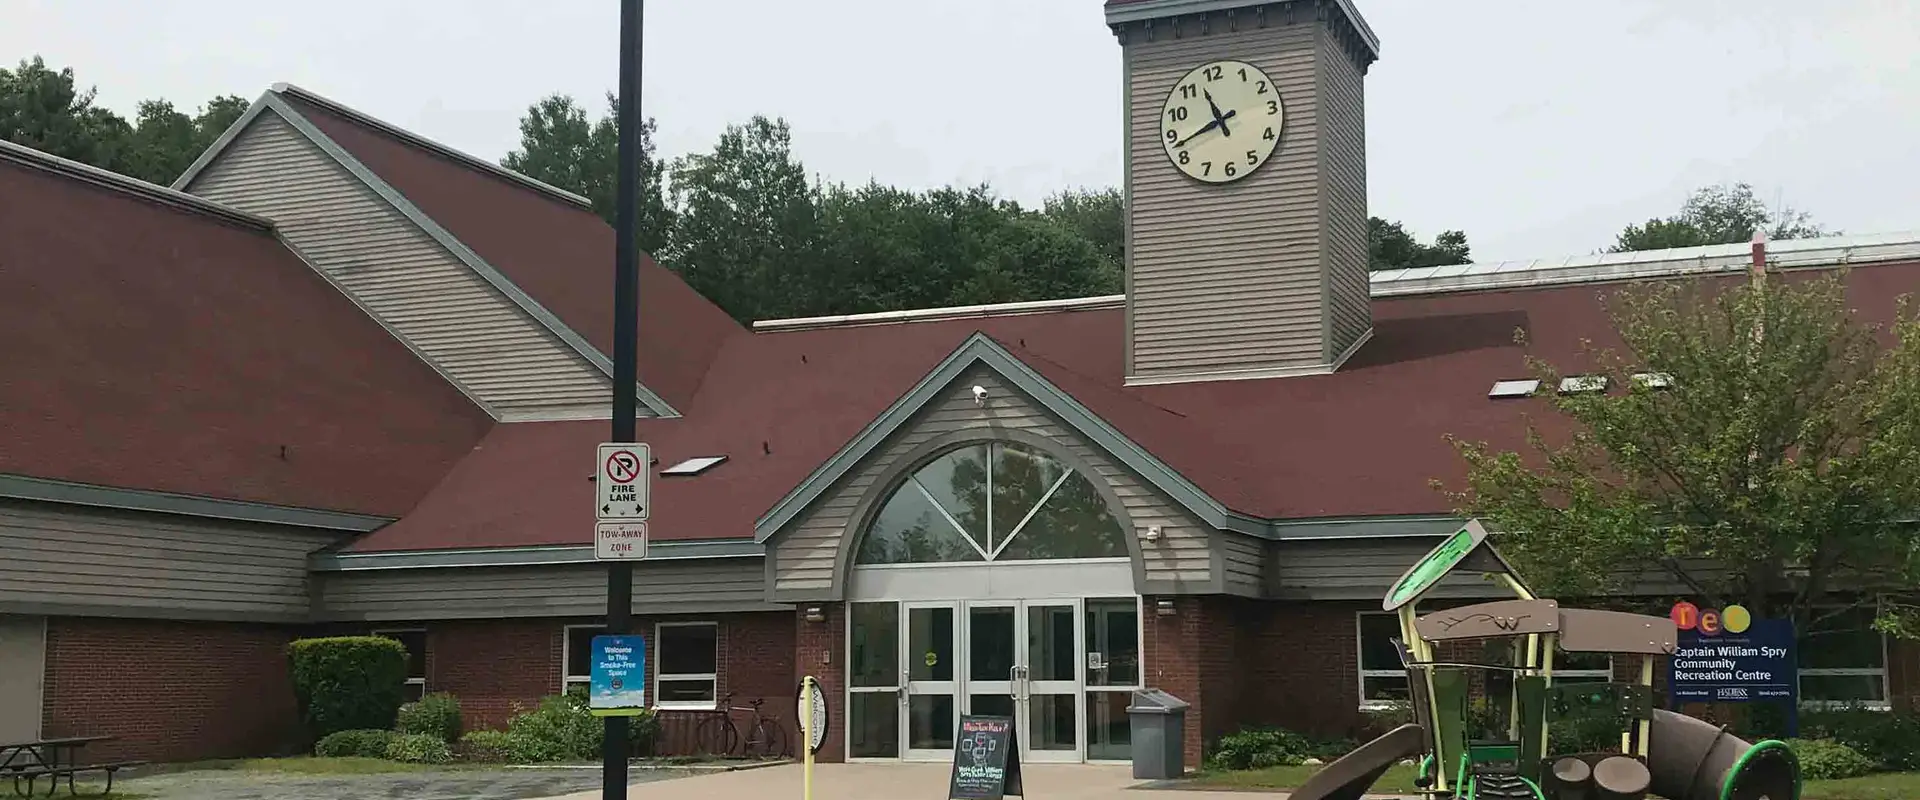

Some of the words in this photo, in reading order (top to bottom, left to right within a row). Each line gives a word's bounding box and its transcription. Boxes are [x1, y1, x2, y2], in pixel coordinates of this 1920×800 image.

[1203, 66, 1223, 82] 12
[1238, 68, 1247, 82] 1
[1179, 84, 1197, 99] 11
[1255, 81, 1268, 95] 2
[1168, 106, 1188, 122] 10
[1267, 100, 1278, 115] 3
[1166, 129, 1178, 143] 9
[1263, 127, 1274, 141] 4
[1178, 151, 1190, 165] 8
[1246, 150, 1258, 165] 5
[1201, 162, 1212, 176] 7
[1224, 162, 1236, 176] 6
[611, 485, 635, 493] FIRE
[609, 494, 637, 502] LANE
[600, 530, 643, 539] TOW-AWAY
[610, 543, 633, 551] ZONE
[604, 646, 633, 654] Welcome
[1675, 647, 1715, 658] Captain
[1717, 646, 1758, 657] William
[1761, 646, 1787, 658] Spry
[600, 661, 637, 669] Smoke-Free
[1674, 659, 1736, 670] Community
[608, 669, 628, 677] Space
[1675, 670, 1732, 681] Recreation
[1735, 670, 1772, 681] Centre
